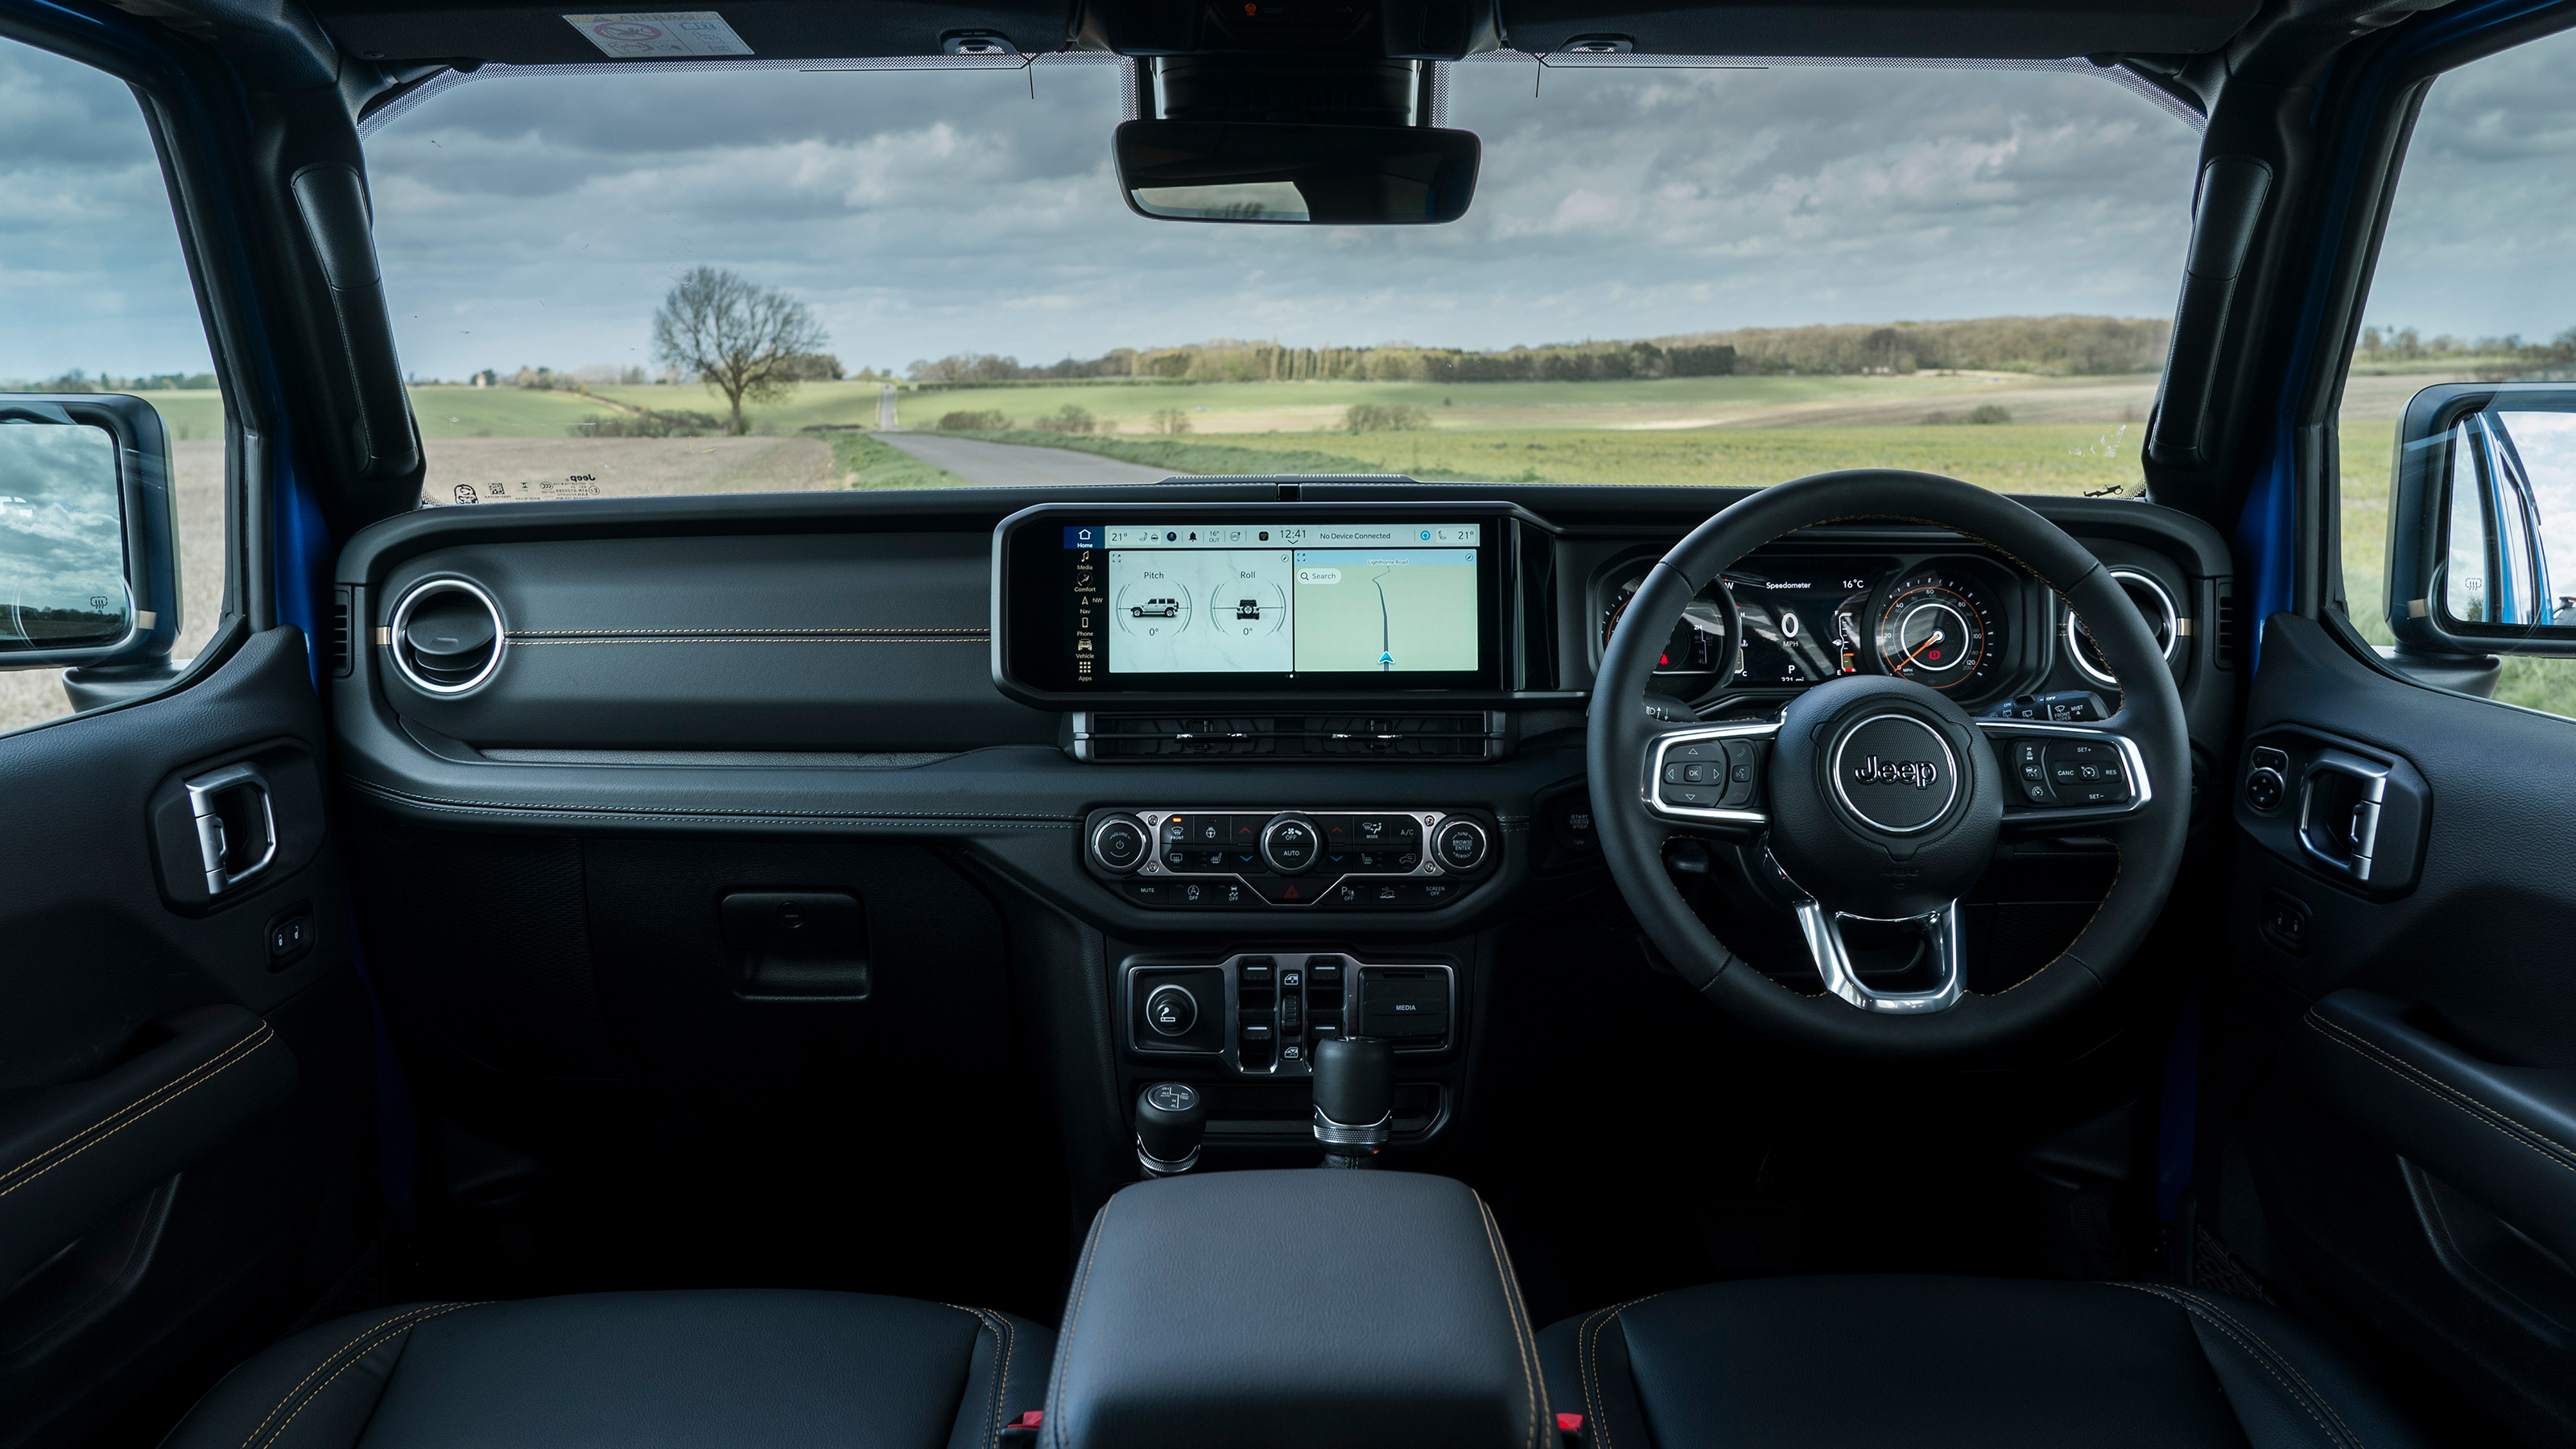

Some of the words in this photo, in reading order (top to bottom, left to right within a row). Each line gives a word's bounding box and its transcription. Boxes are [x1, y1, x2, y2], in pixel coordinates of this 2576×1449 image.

[1112, 532, 1128, 542] 21°
[1280, 530, 1307, 539] 12:41
[1458, 530, 1475, 540] 21°
[1144, 572, 1164, 580] Pitch
[1766, 582, 1811, 590] Speedometer
[1843, 579, 1864, 588] 16°C
[1781, 613, 1799, 638] 0
[1788, 665, 1796, 674] P
[1854, 755, 1938, 790] Jeep
[1401, 828, 1414, 836] A/C
